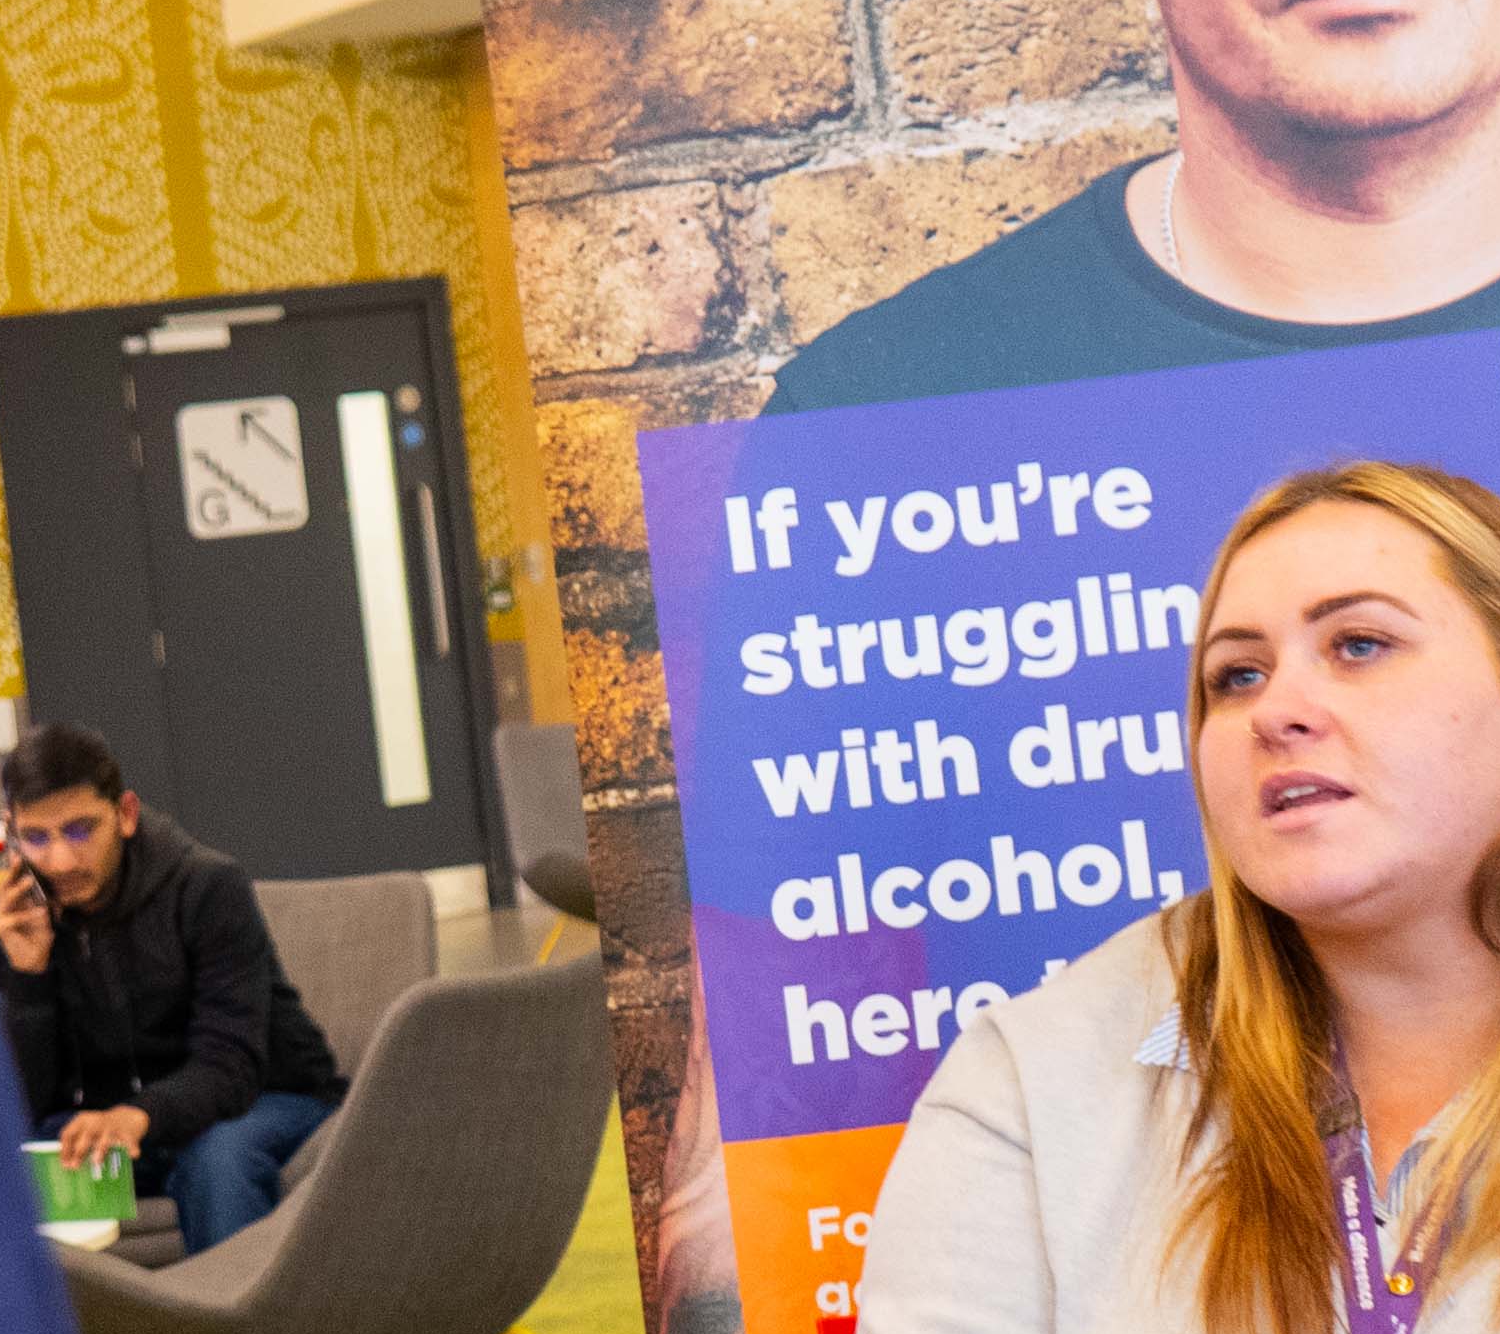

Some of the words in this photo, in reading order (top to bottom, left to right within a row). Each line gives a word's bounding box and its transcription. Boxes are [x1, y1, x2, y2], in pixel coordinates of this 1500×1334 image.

[725, 486, 799, 575] If
[739, 574, 1199, 695] strugglin
[752, 718, 979, 821] with
[1010, 703, 1184, 792] dru
[770, 818, 1184, 942] alcohol,
